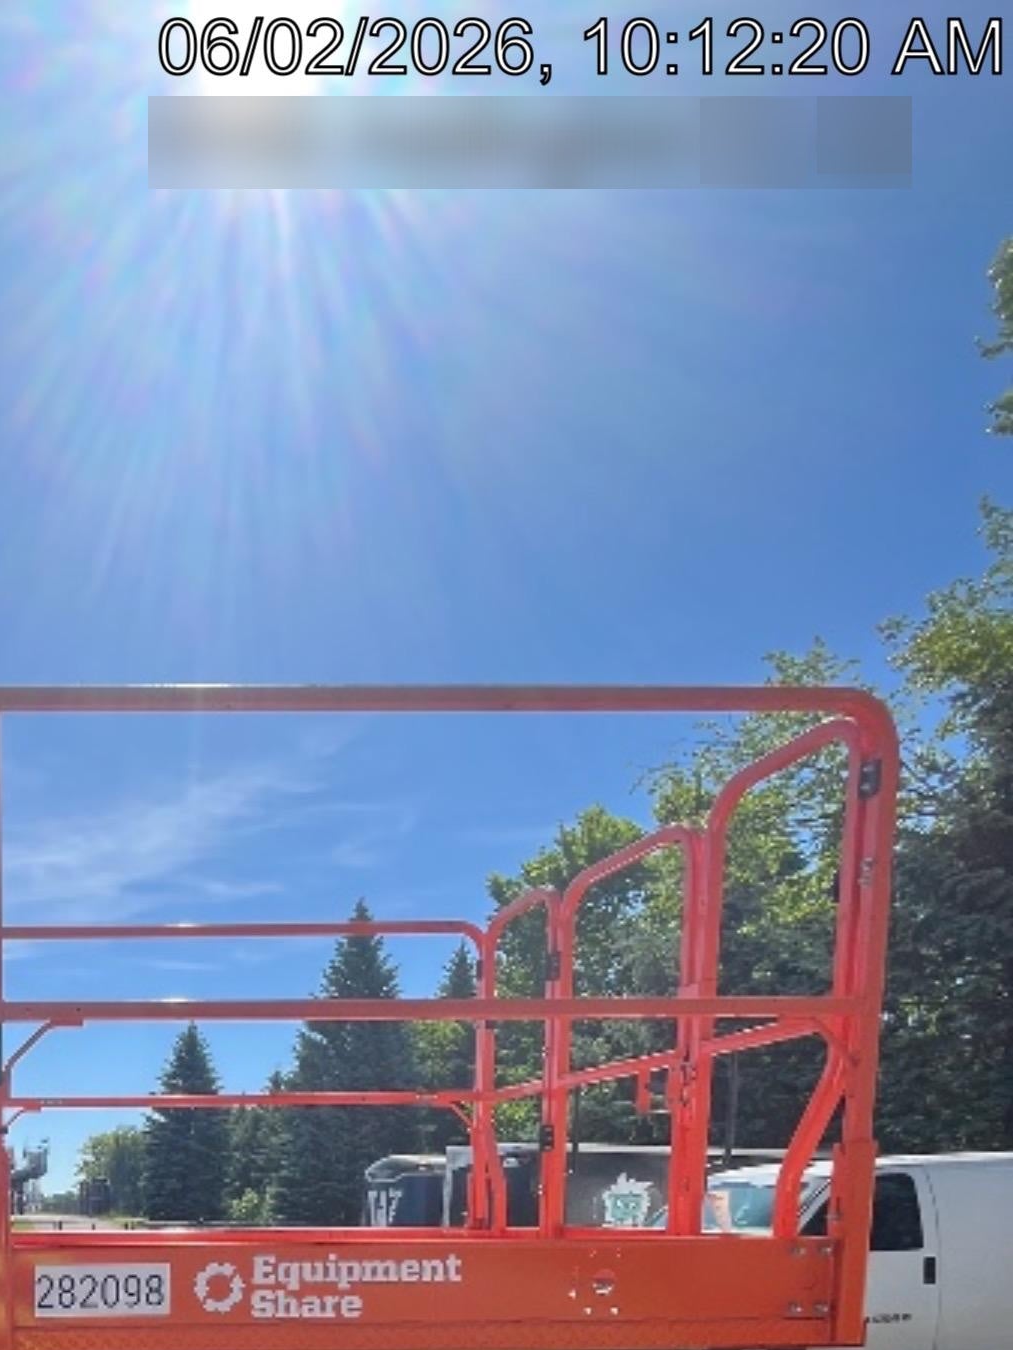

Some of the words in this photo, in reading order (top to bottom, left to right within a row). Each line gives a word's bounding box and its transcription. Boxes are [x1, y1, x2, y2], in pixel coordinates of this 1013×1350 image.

[252, 1254, 462, 1286] Equipment
[36, 1273, 166, 1309] 282098
[251, 1293, 363, 1319] Share
